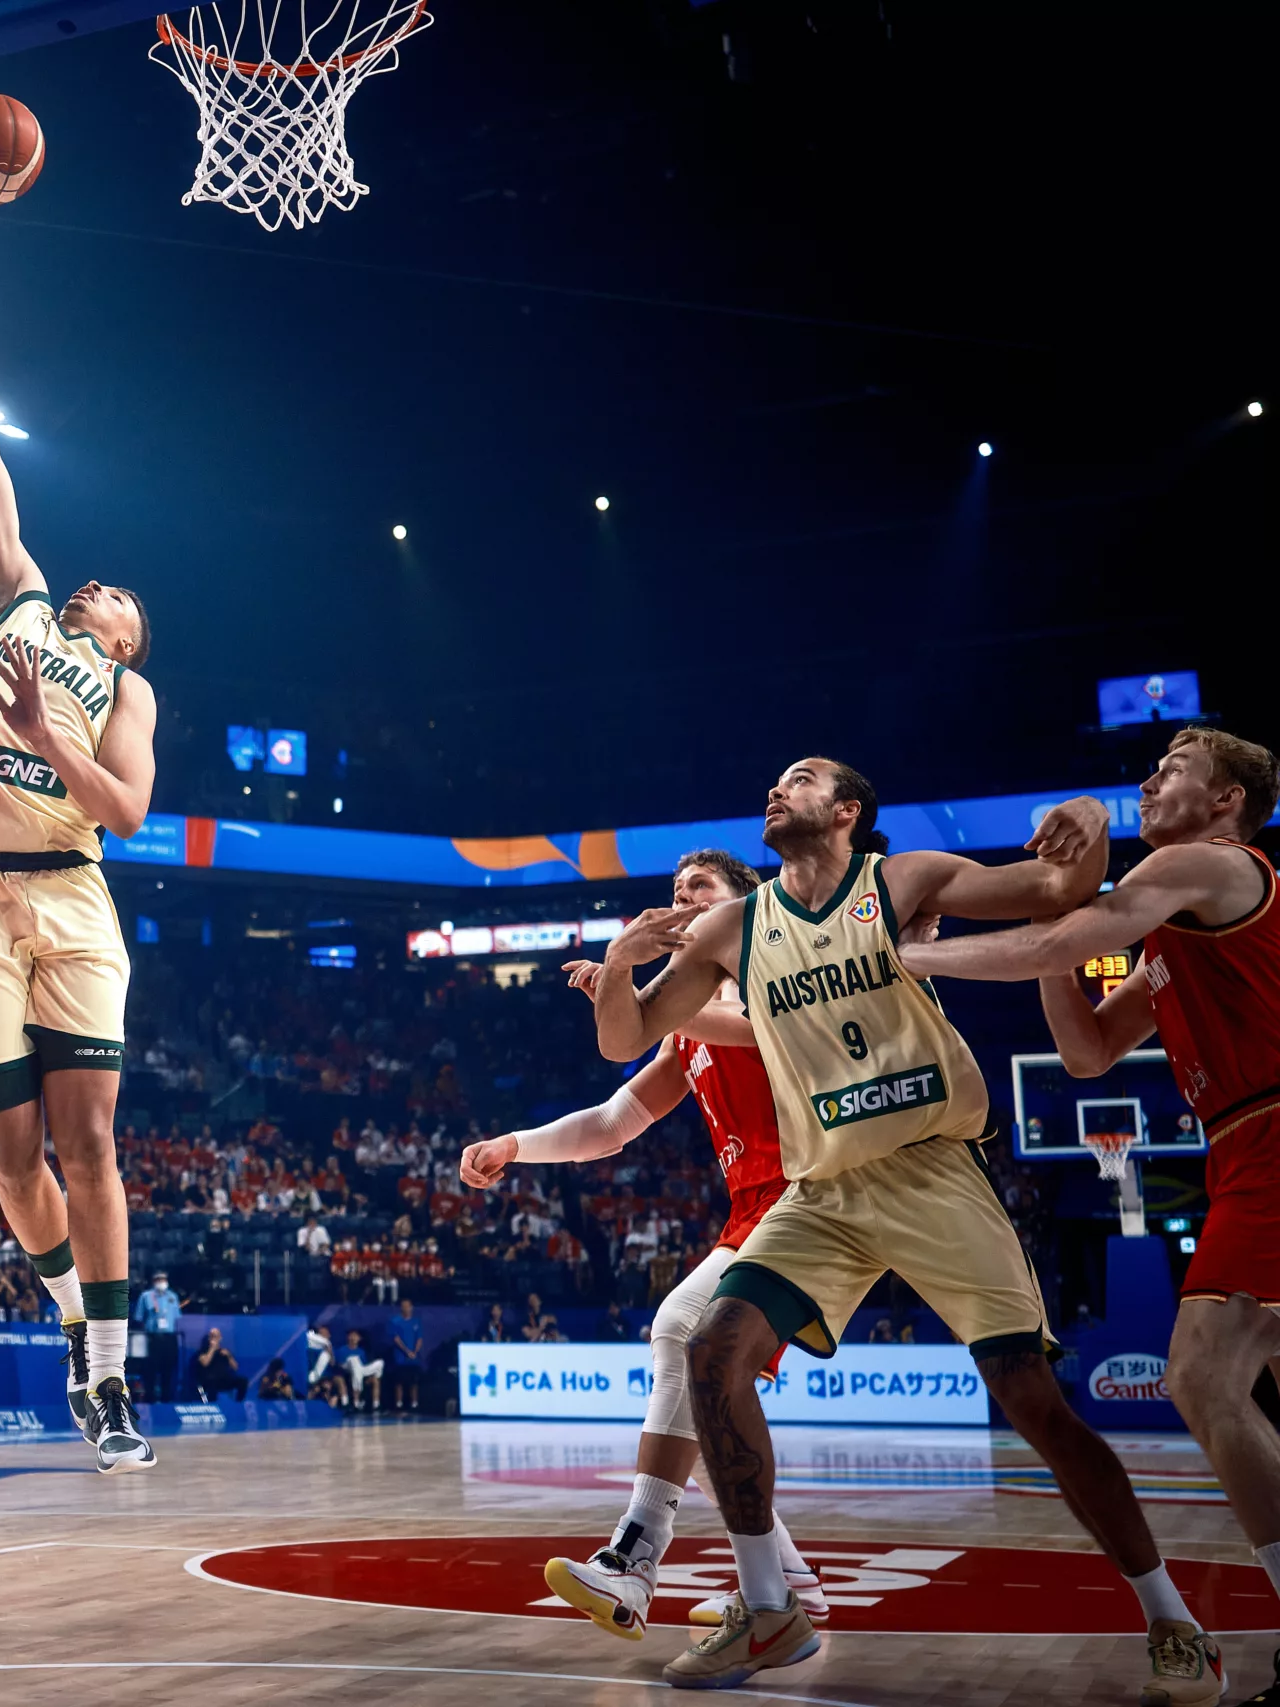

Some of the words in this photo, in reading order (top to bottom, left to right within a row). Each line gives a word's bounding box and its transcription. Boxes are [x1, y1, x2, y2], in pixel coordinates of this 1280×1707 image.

[766, 950, 903, 1018] AUSTRALIA
[841, 1021, 869, 1061] 9
[840, 1072, 933, 1118] SIGNET
[506, 1371, 552, 1390] PCA
[562, 1371, 609, 1391] Hub
[851, 1373, 977, 1396] PCAサブスク
